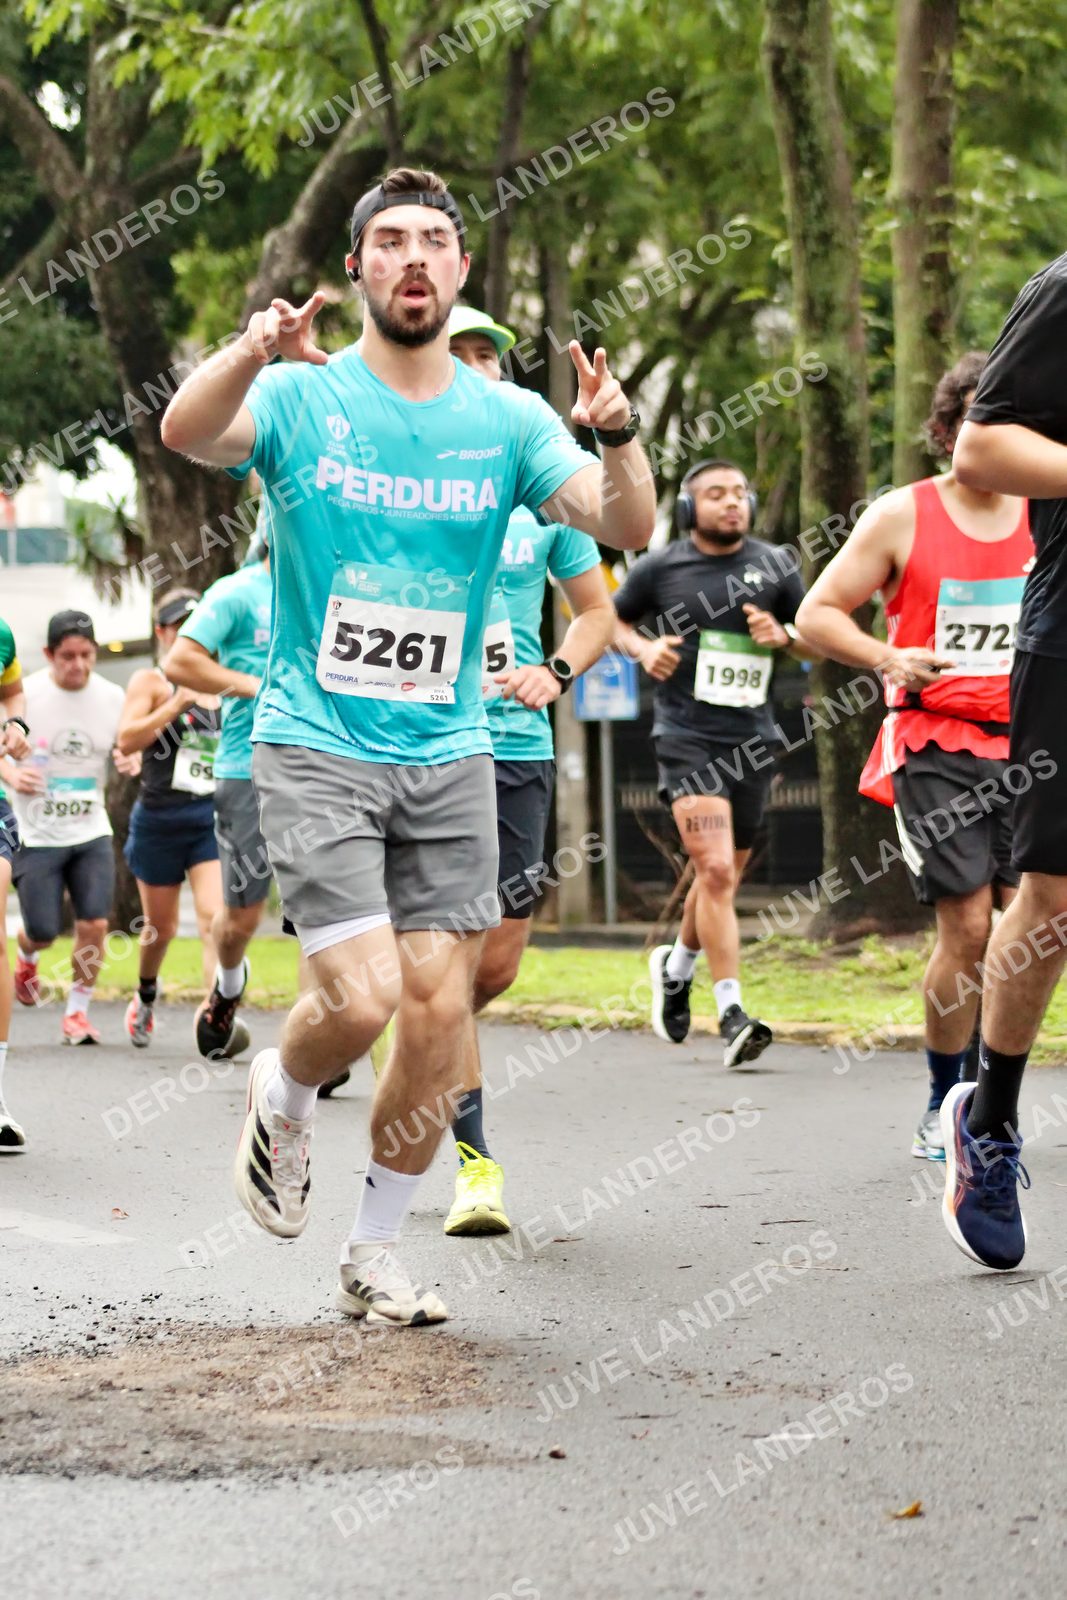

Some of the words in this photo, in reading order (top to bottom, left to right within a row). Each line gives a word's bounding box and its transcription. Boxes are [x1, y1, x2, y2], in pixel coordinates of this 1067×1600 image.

[458, 445, 504, 460] BROOKS
[316, 456, 498, 512] PERDURA
[327, 495, 351, 509] PEGA
[352, 500, 379, 516] PISOS
[384, 509, 449, 522] JUNTEADORES
[329, 622, 448, 674] 5261
[944, 622, 1018, 652] 272
[325, 672, 359, 684] PERDURA
[705, 664, 762, 689] 1998
[430, 694, 449, 702] 5261
